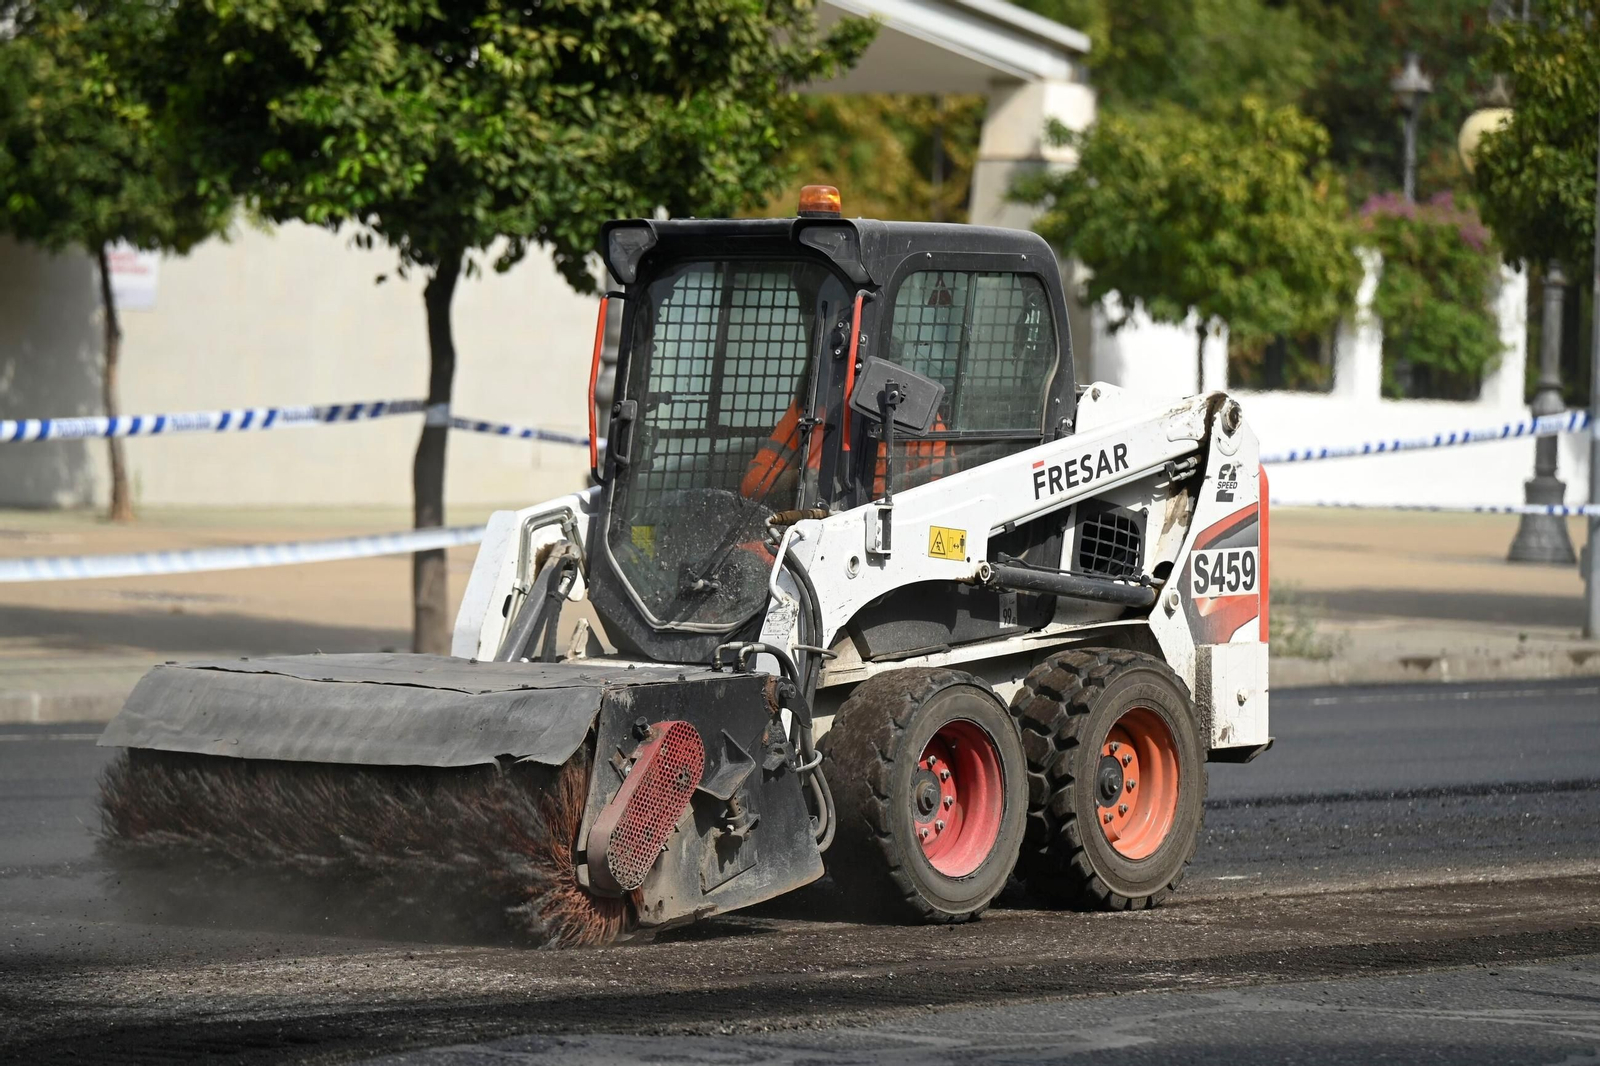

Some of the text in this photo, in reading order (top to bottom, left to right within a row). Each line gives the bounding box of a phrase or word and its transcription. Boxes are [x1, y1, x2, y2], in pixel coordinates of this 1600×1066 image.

[1032, 443, 1129, 500] FRESAR
[1217, 481, 1238, 490] SPEED
[1194, 550, 1256, 594] S459
[1003, 607, 1012, 625] 99
